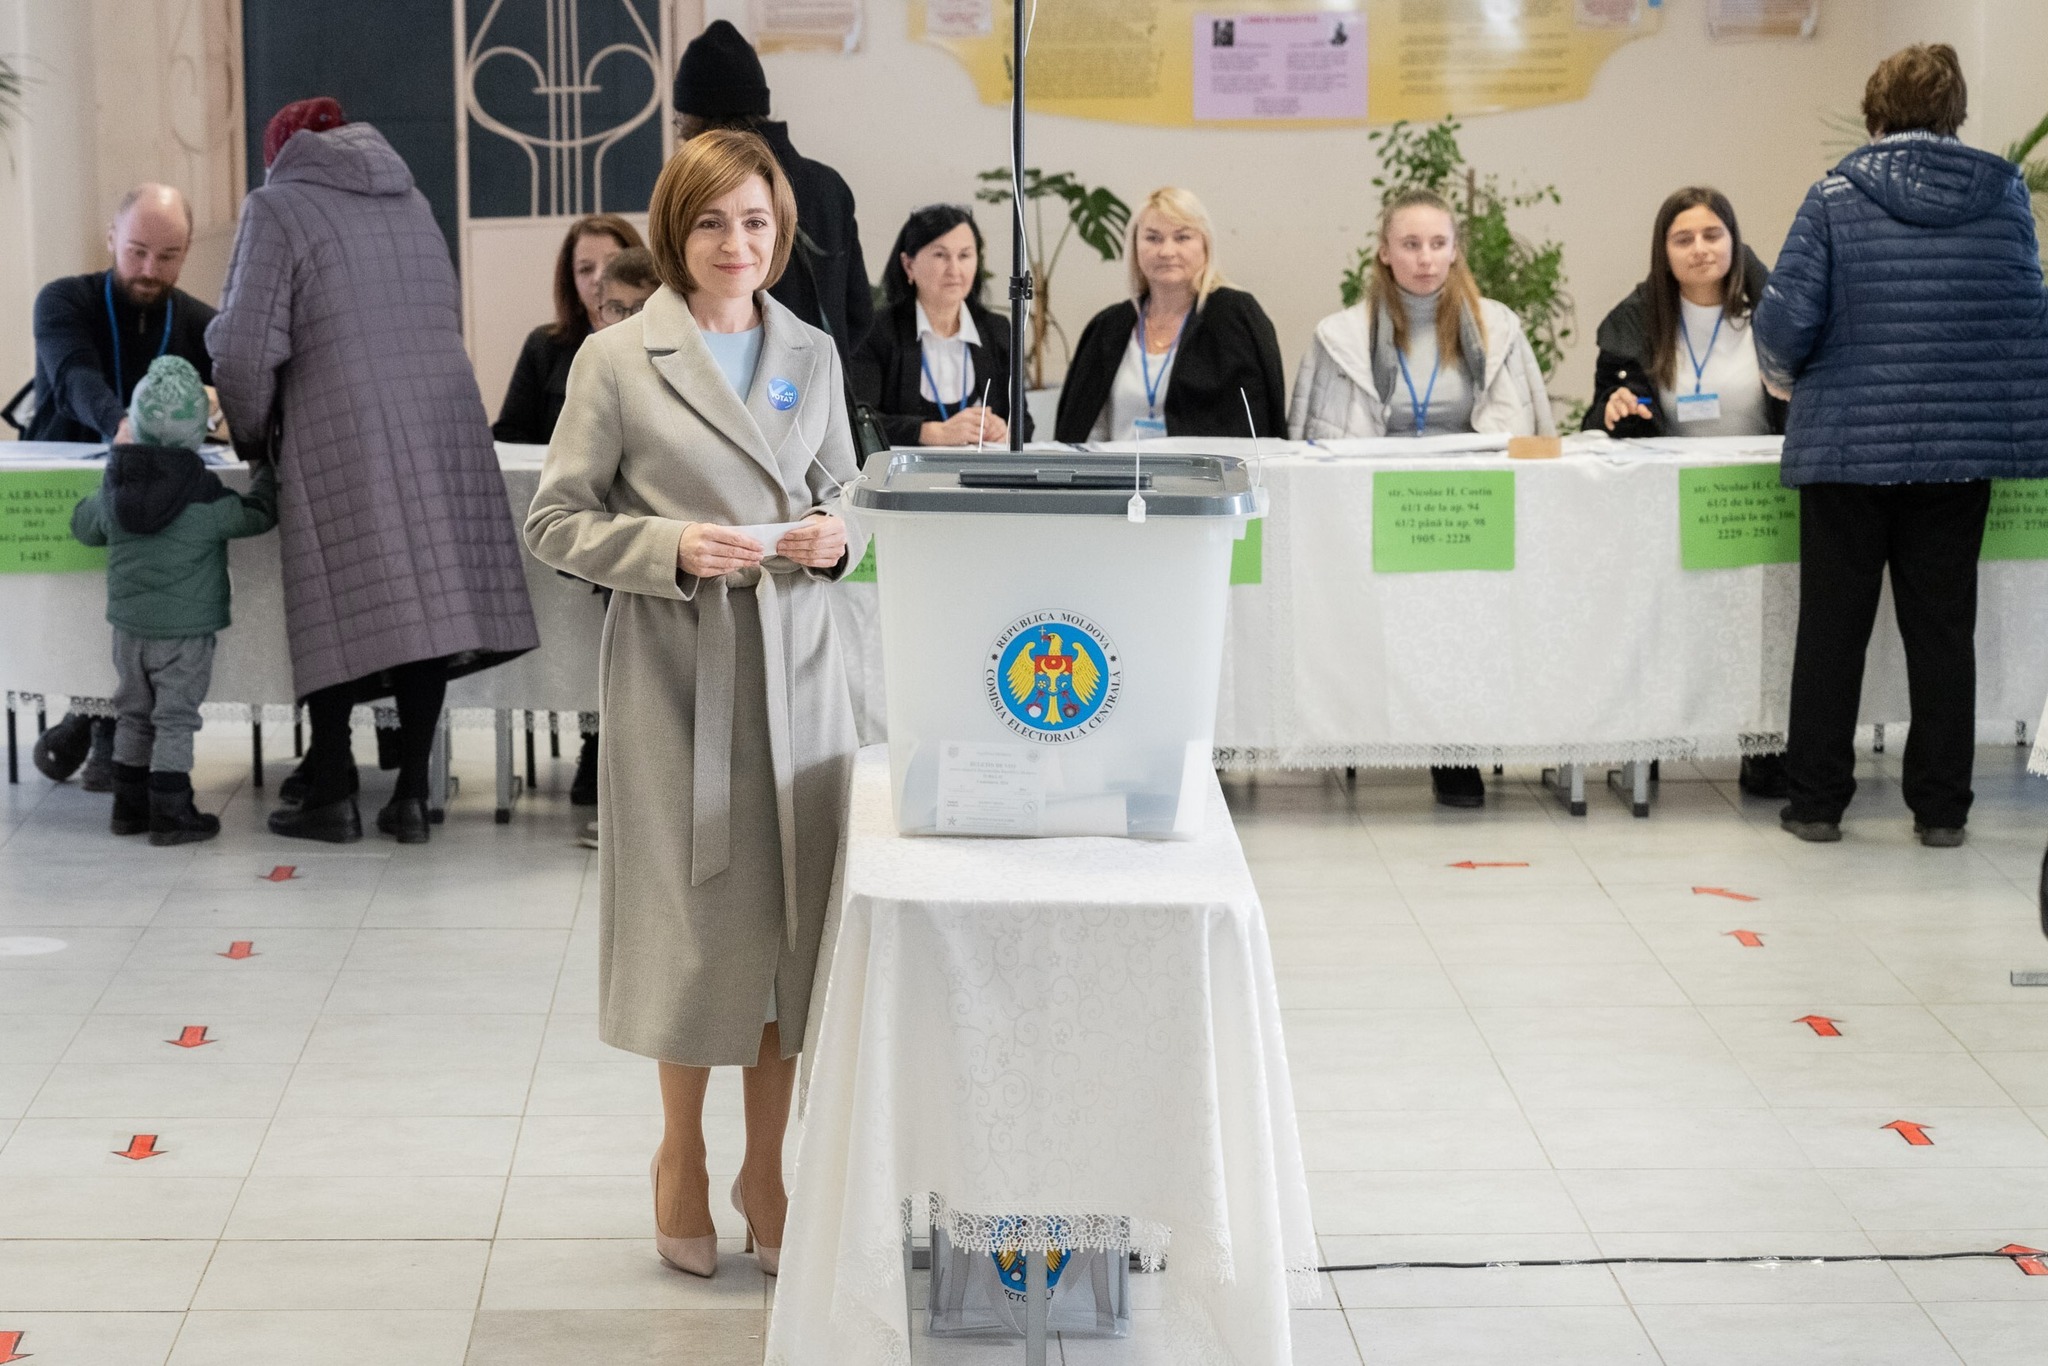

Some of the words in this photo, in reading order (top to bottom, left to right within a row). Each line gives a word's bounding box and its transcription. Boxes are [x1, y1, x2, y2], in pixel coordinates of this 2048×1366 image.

[771, 393, 793, 403] VOTAT
[1408, 487, 1442, 496] Nicolae
[1730, 498, 1741, 507] de
[1744, 497, 1754, 506] la
[1424, 503, 1435, 512] de
[1438, 503, 1447, 512] la
[1748, 512, 1757, 521] la
[1445, 518, 1453, 527] la
[1411, 534, 1435, 544] 1905
[995, 612, 1055, 649] REPUBLICA
[1061, 612, 1110, 650] MOLDOVA
[985, 668, 1005, 719] COMISIA
[1007, 718, 1087, 743] ELECTORALĂ
[1088, 670, 1121, 729] CENTRALĂ
